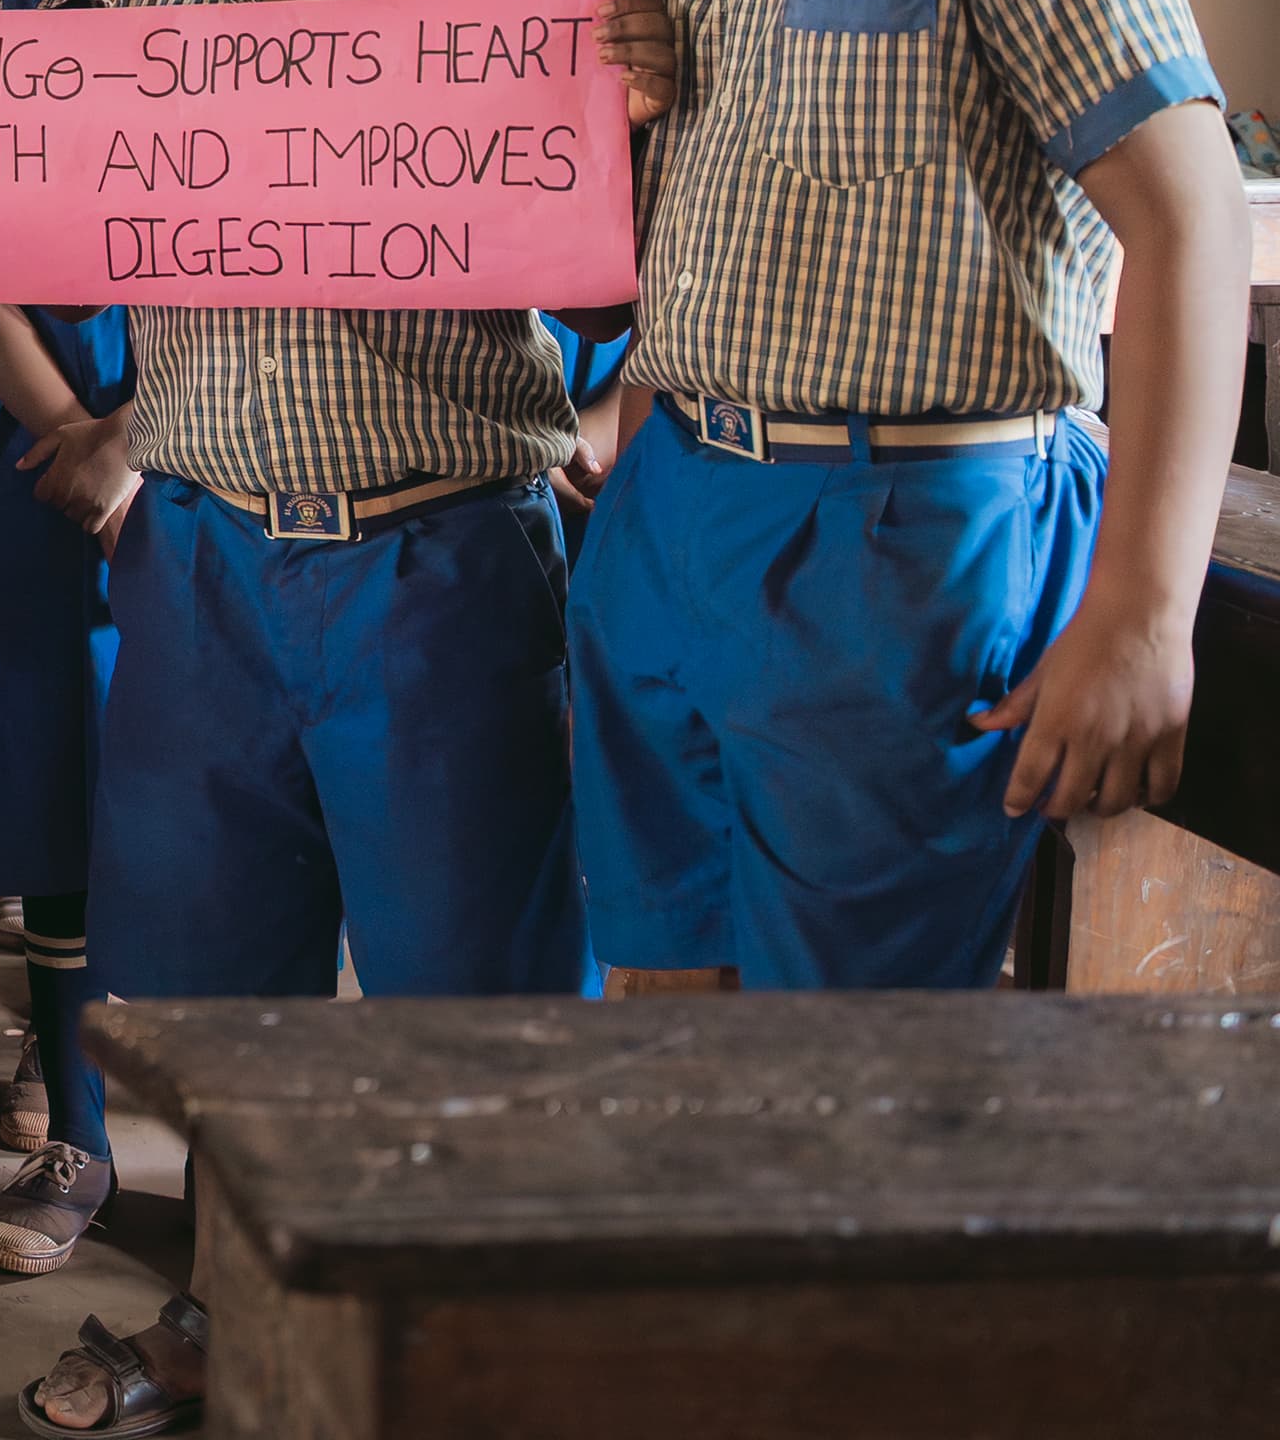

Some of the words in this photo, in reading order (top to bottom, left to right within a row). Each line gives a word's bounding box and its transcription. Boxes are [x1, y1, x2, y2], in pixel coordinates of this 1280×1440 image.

[136, 27, 383, 99] SUPPORTS
[416, 15, 594, 84] HEART
[97, 128, 231, 193] AND
[264, 121, 577, 192] IMPROVES
[104, 216, 470, 282] DIGESTION
